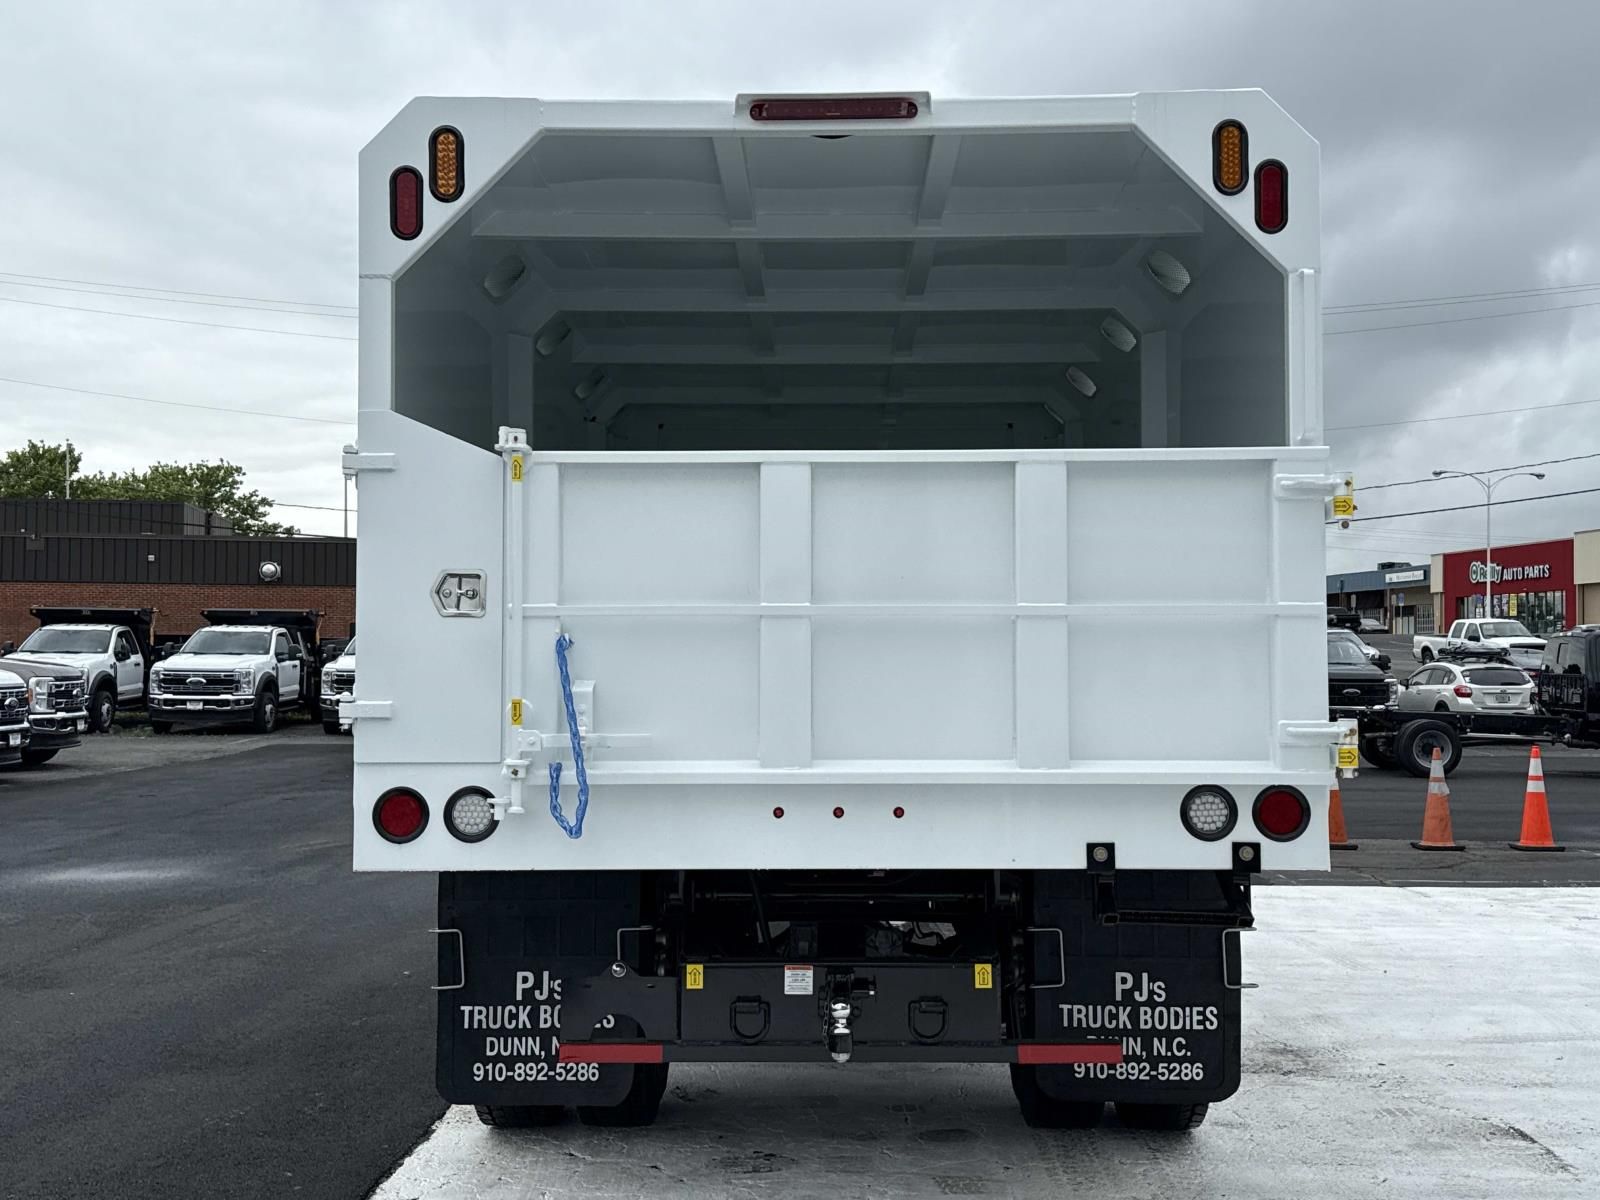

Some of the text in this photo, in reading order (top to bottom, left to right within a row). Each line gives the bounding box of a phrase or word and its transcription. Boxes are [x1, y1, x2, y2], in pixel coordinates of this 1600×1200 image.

[1503, 567, 1523, 580] AUTO
[1524, 564, 1550, 579] PARTS
[460, 1005, 532, 1029] TRUCK
[1059, 1004, 1218, 1030] TRUCK BODIES
[485, 1036, 546, 1059] DUNN,
[1153, 1036, 1192, 1057] N.C.
[473, 1062, 600, 1082] 910-892-5286
[1073, 1062, 1204, 1081] 910-892-5286
